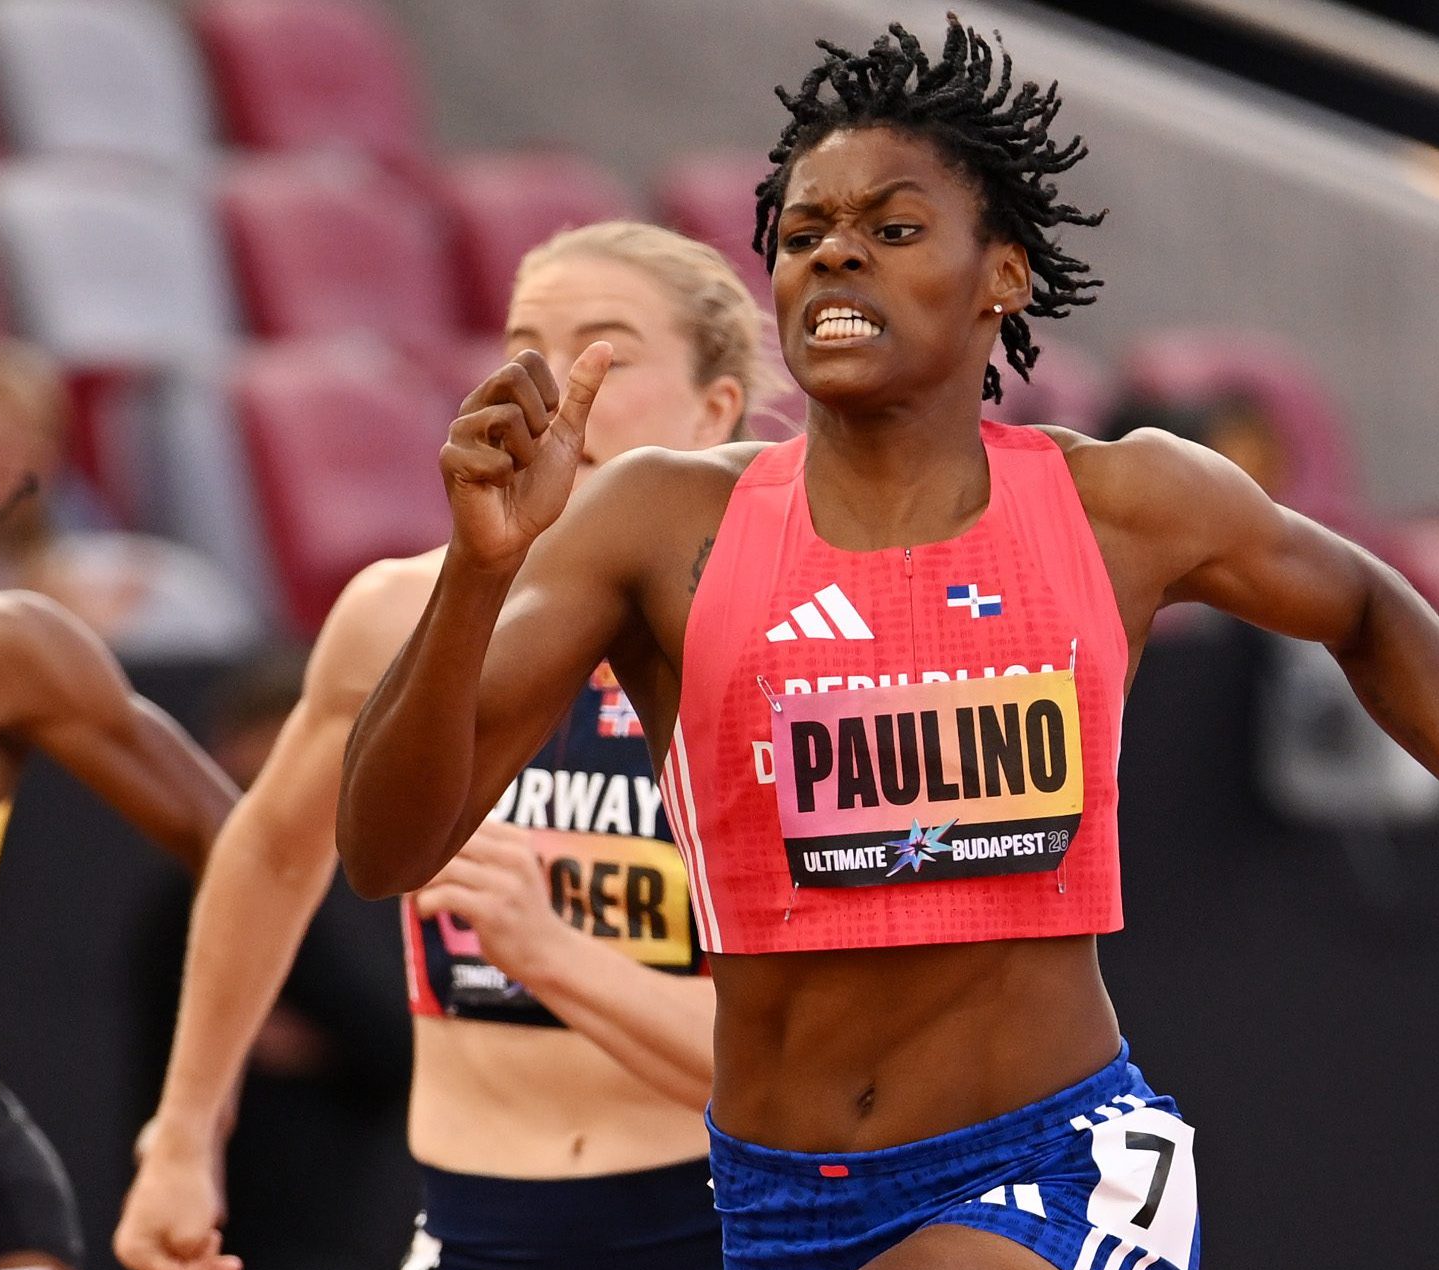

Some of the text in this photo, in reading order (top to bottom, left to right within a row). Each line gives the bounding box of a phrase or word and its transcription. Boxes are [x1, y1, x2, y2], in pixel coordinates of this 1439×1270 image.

[790, 699, 1067, 813] PAULINO
[484, 767, 661, 837] RWAY
[803, 830, 1070, 872] ULTIMATE BUDAPEST 26
[537, 856, 668, 939] GER
[1125, 1130, 1176, 1230] 7
